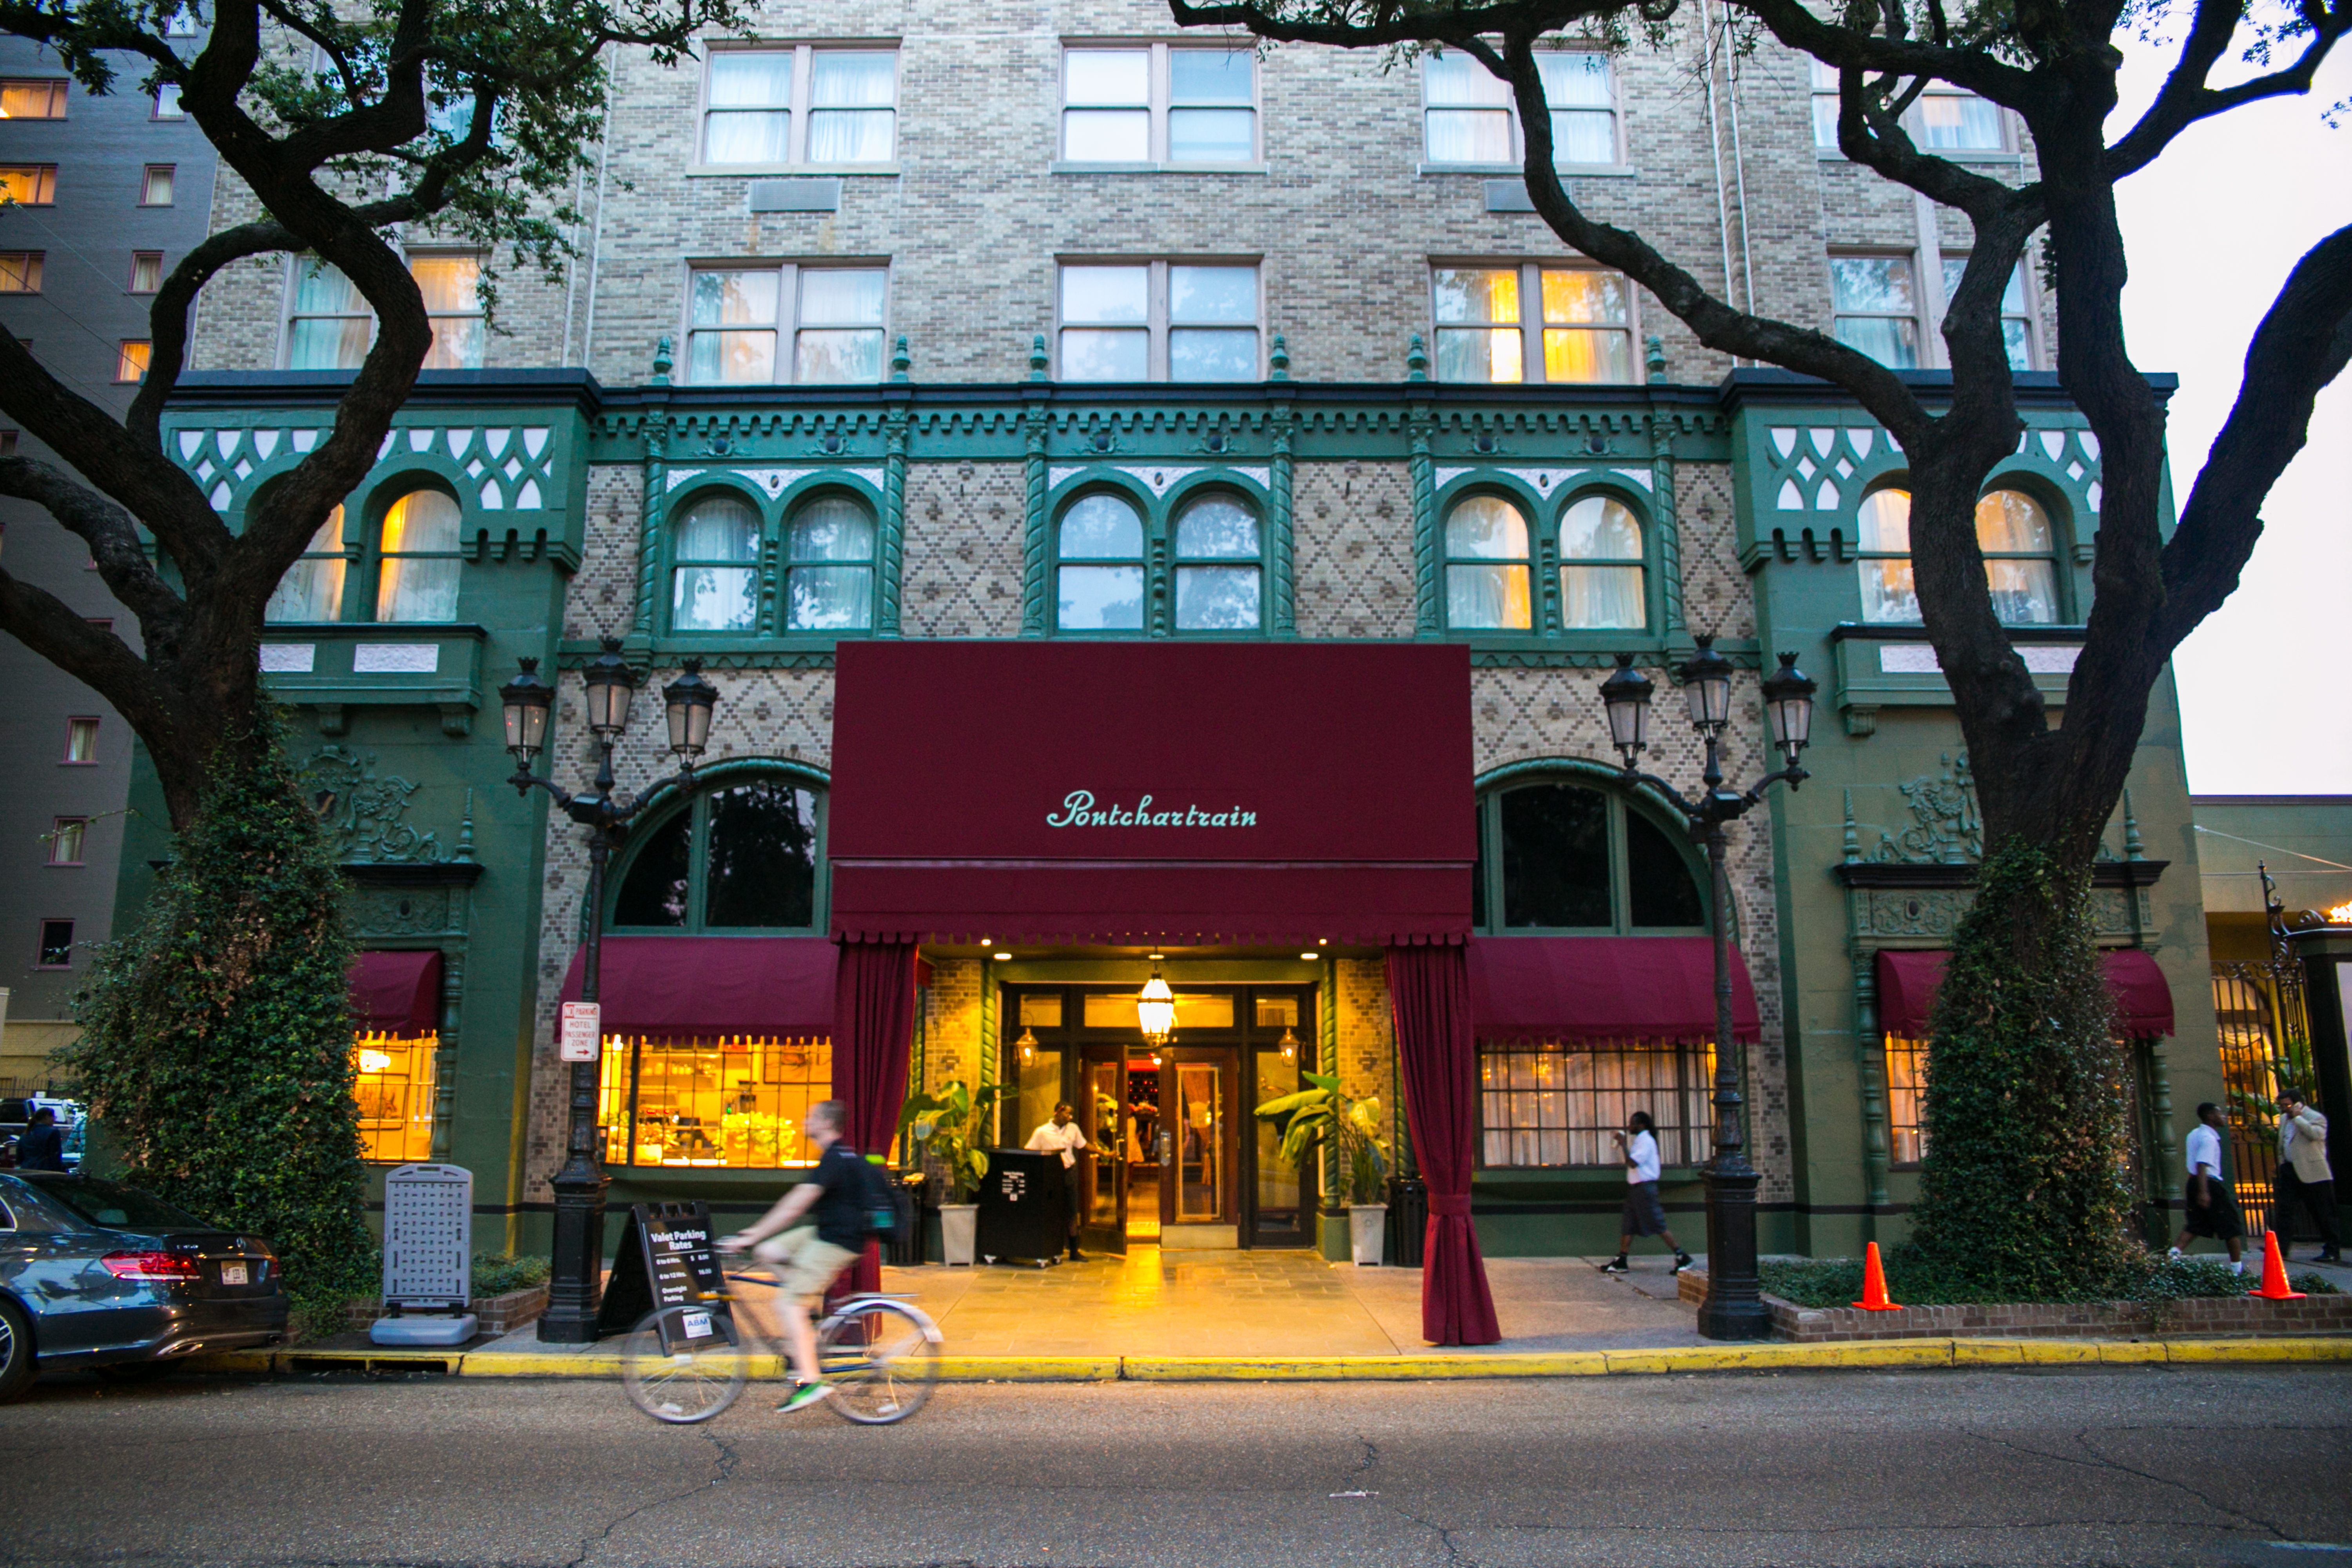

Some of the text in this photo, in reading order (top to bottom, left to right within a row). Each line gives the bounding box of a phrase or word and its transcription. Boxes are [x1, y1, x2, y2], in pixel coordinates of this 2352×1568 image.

[1046, 789, 1257, 827] Pontchartrain
[565, 1006, 574, 1016] NO
[651, 1230, 706, 1242] Valet Parking
[669, 1241, 693, 1250] Rates
[688, 1318, 708, 1327] ABM
